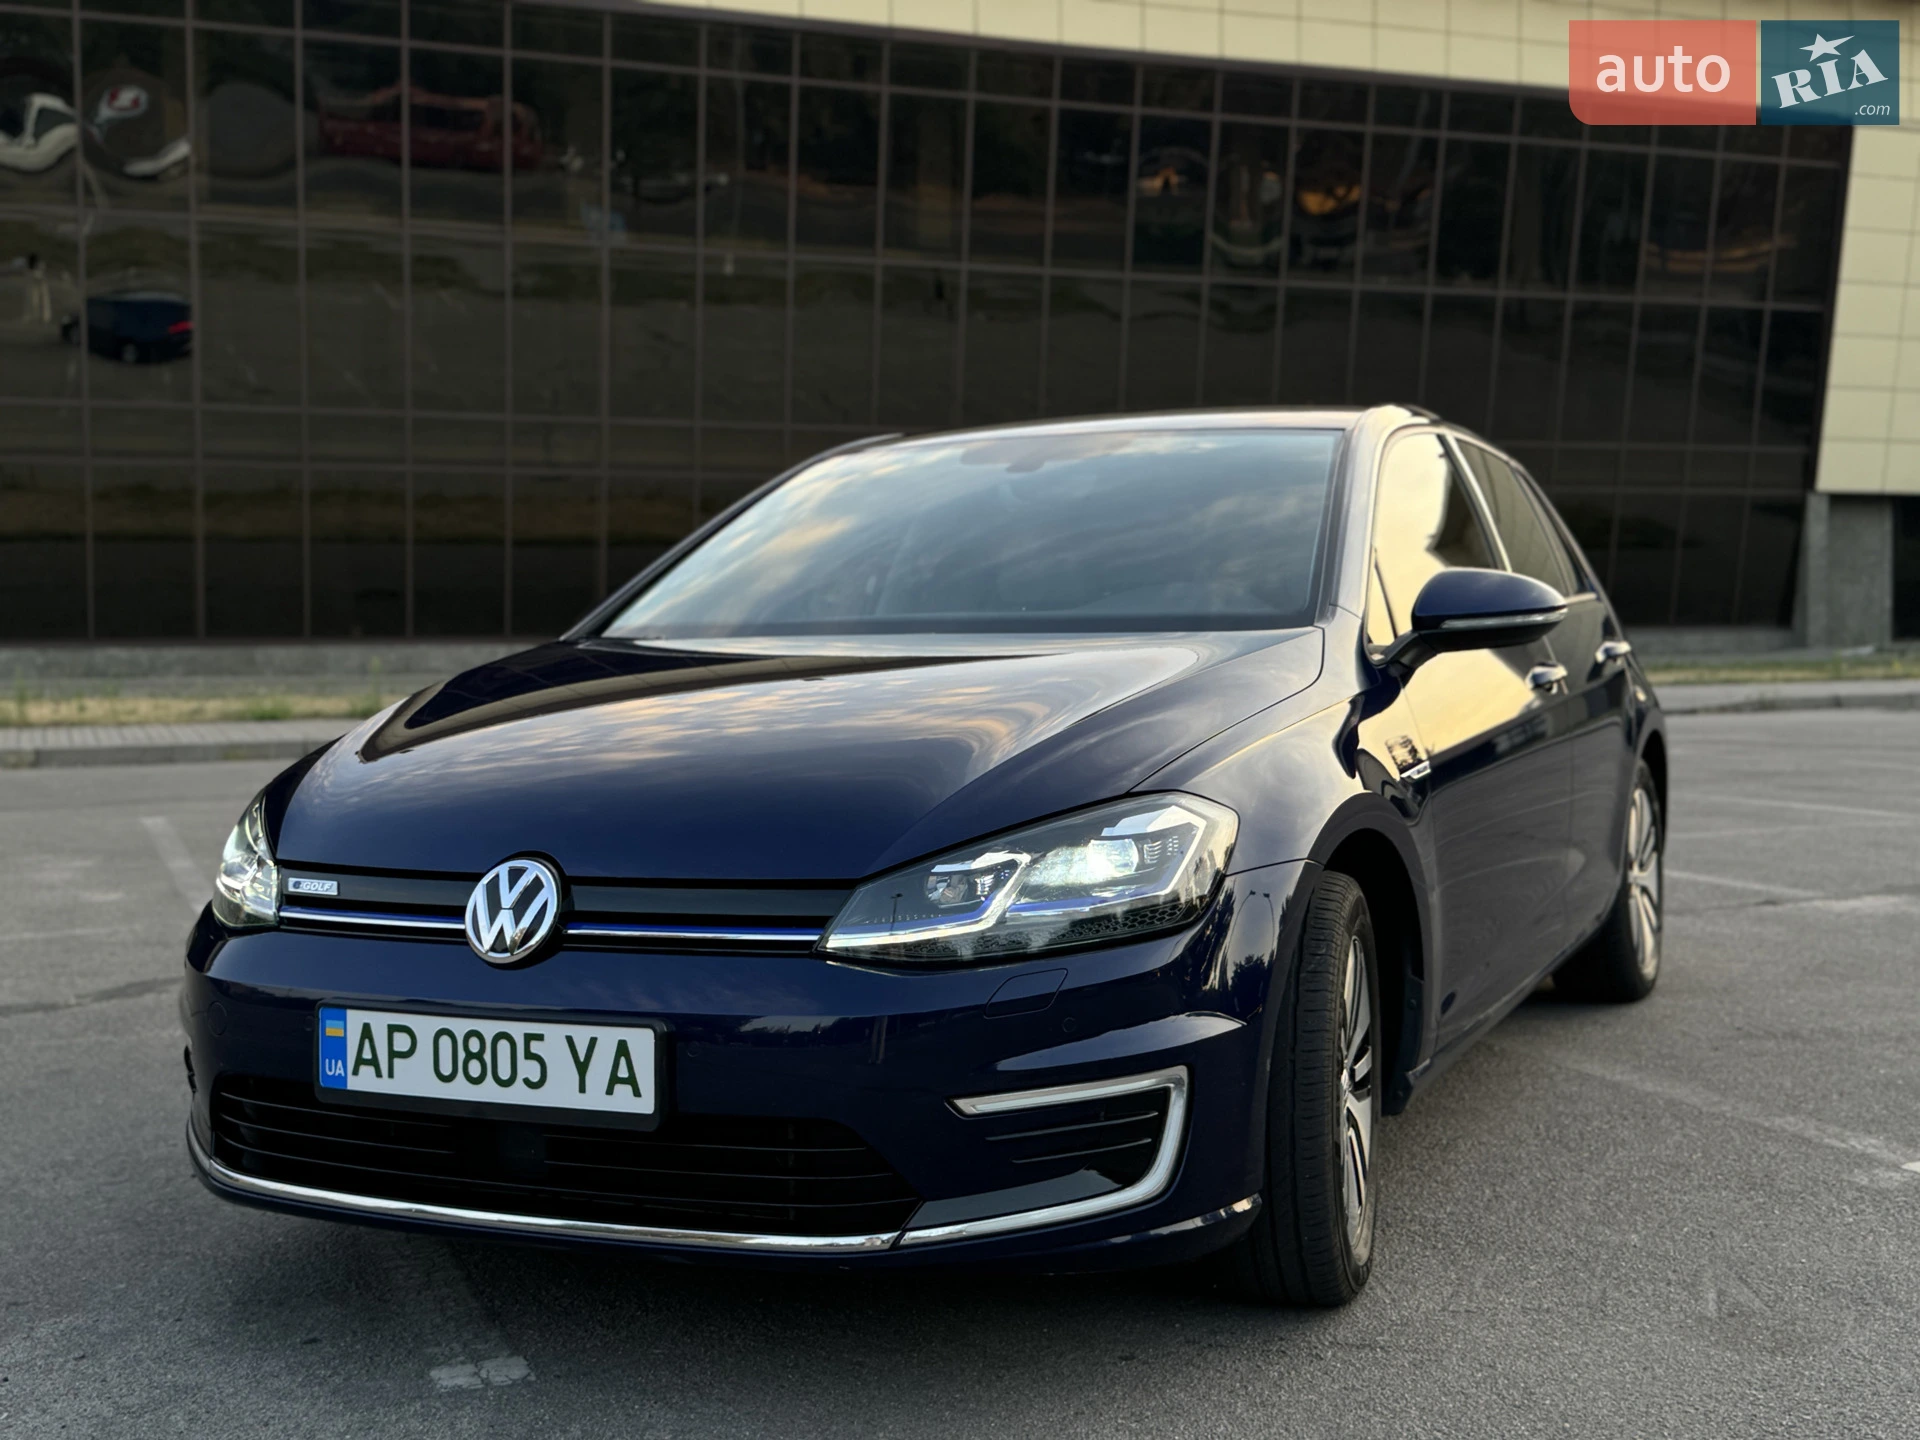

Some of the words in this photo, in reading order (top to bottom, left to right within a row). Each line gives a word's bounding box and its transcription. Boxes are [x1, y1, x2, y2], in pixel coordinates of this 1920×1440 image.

[467, 860, 557, 957] VW
[325, 1058, 345, 1077] UA
[351, 1022, 418, 1079] AP
[432, 1027, 548, 1090] 0805
[564, 1034, 643, 1098] YA
